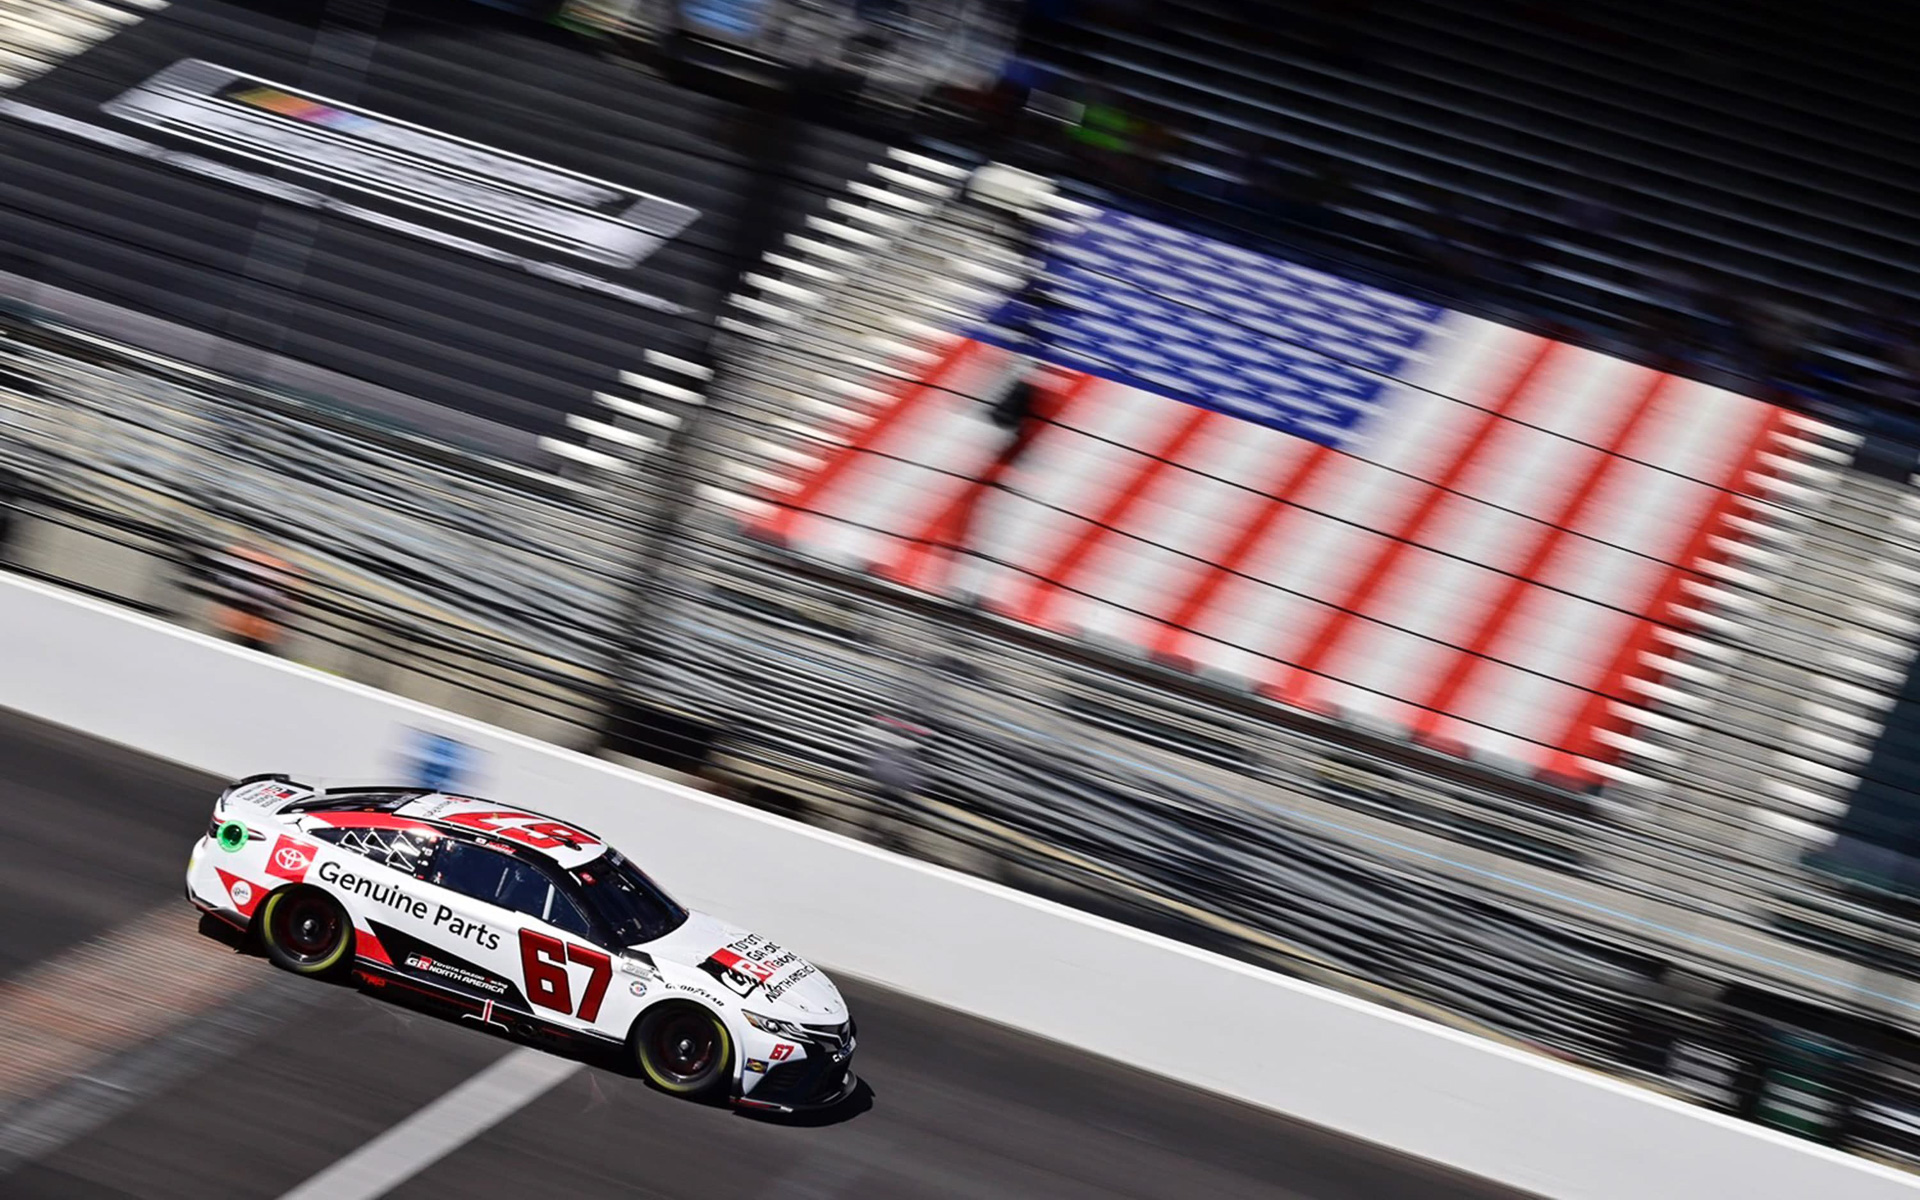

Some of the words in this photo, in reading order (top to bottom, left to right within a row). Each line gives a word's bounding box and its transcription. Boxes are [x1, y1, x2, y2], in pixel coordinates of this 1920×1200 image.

[318, 861, 428, 919] Genuine
[433, 905, 501, 950] Parts
[406, 956, 431, 971] GR
[518, 928, 613, 1024] 67
[428, 965, 462, 981] NORTH
[462, 977, 505, 995] AMERICA
[769, 1043, 794, 1062] 67
